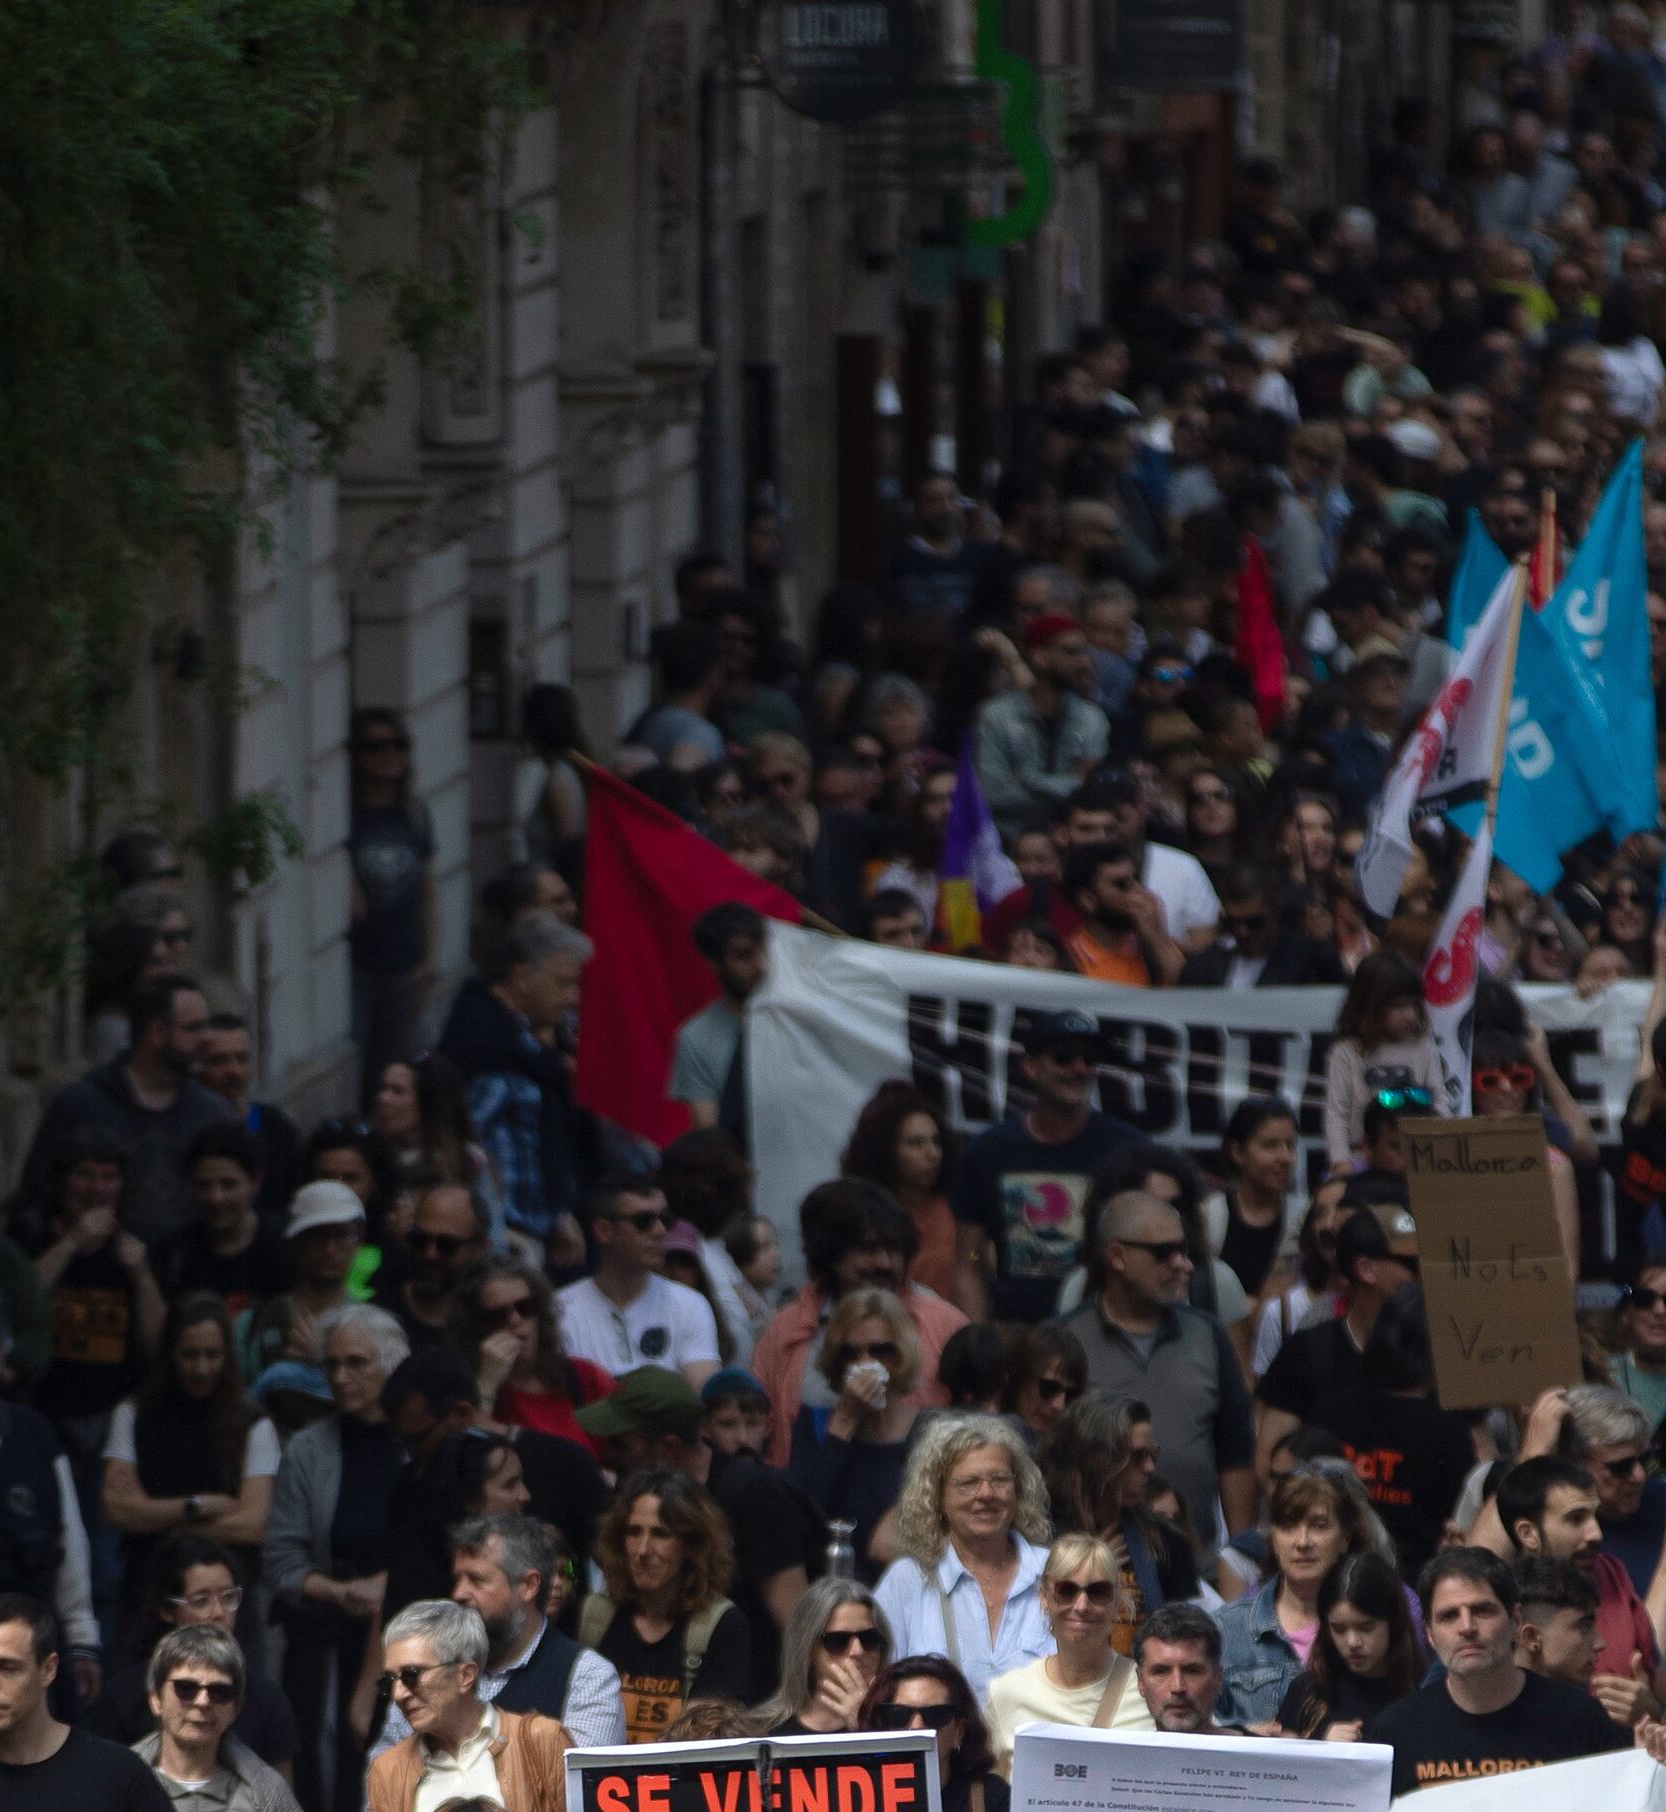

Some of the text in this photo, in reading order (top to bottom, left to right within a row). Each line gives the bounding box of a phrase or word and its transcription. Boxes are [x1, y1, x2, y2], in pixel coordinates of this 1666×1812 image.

[1410, 1136, 1541, 1175] Mallorca
[1181, 1768, 1211, 1777] FELIPE
[1229, 1771, 1246, 1779] REY
[1263, 1771, 1298, 1781] ESPAÑA
[1037, 1798, 1070, 1807] artículo
[1084, 1800, 1095, 1808] de
[1107, 1801, 1159, 1811] Constitución
[1161, 1804, 1197, 1812] establece
